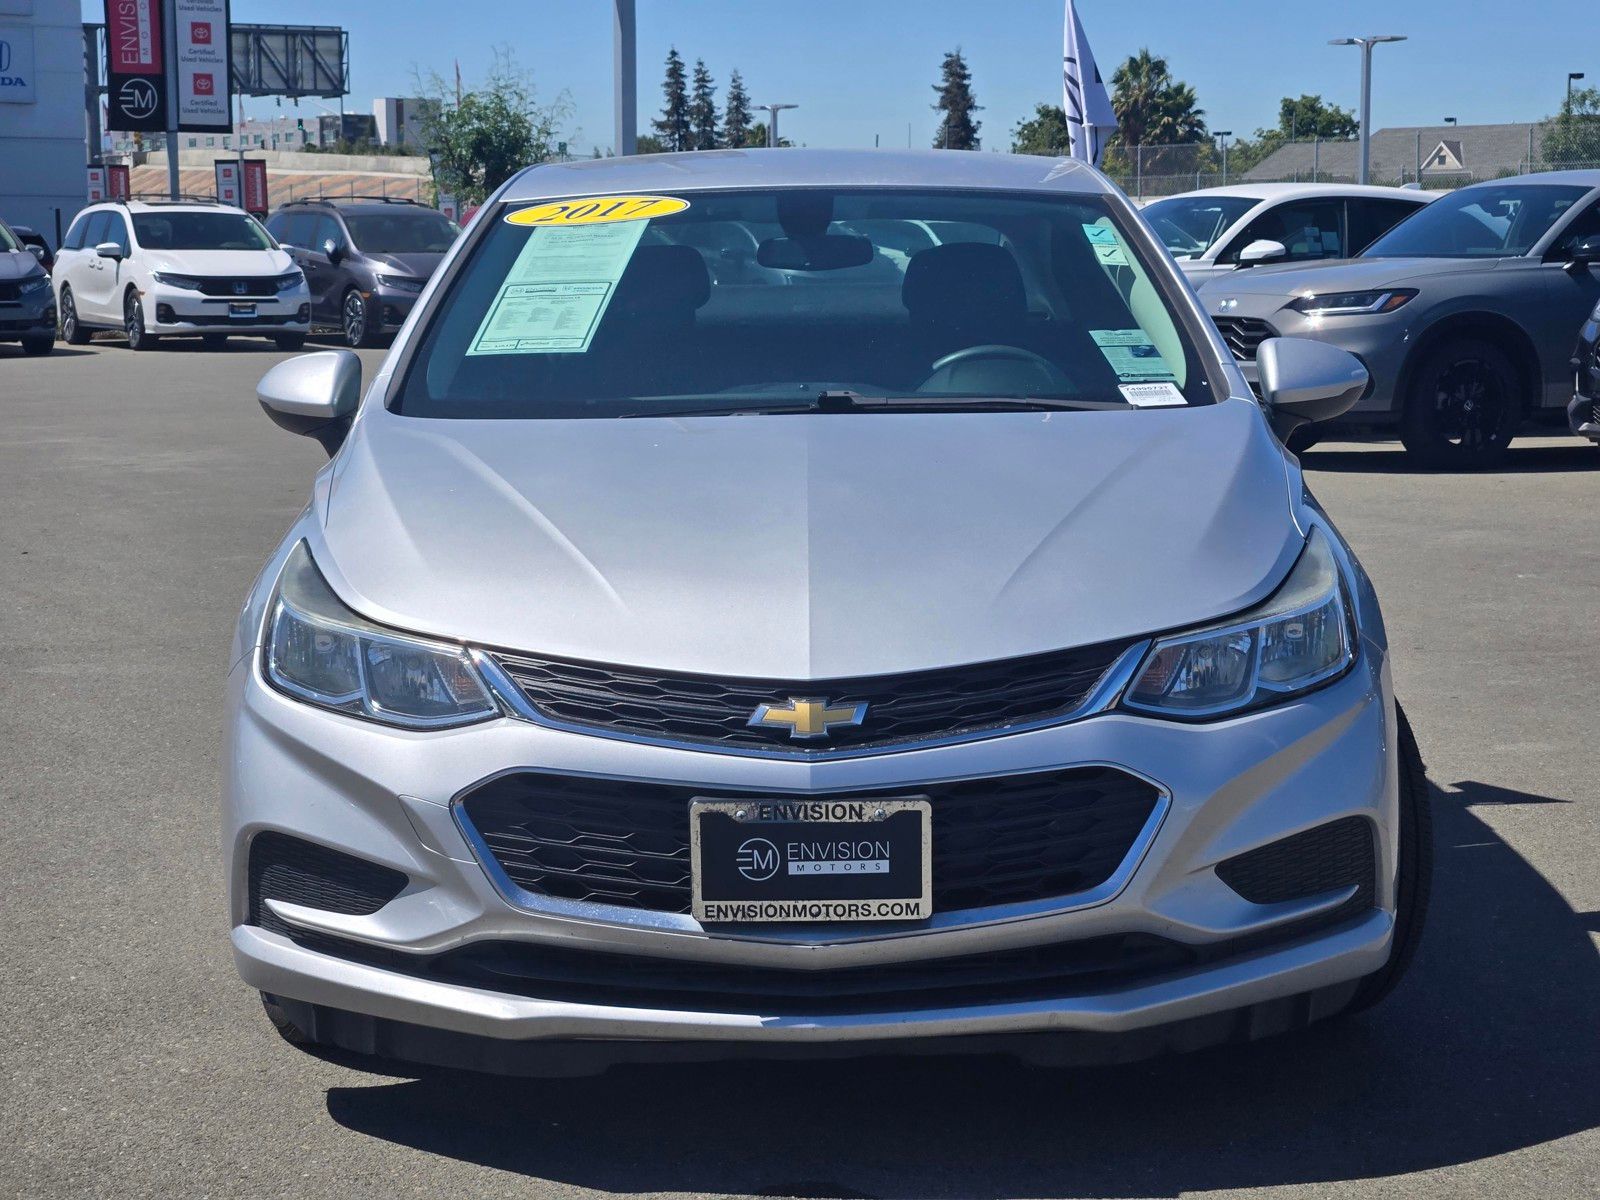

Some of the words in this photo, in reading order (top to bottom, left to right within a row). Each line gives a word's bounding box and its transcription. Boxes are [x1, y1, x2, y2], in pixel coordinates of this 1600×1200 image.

[119, 0, 138, 63] ENVIS
[533, 200, 663, 222] 2017
[759, 803, 863, 821] ENVISION
[787, 841, 890, 860] ENVISION
[797, 863, 880, 872] MOTORS
[704, 903, 920, 919] ENVISIONMOTORS.COM
